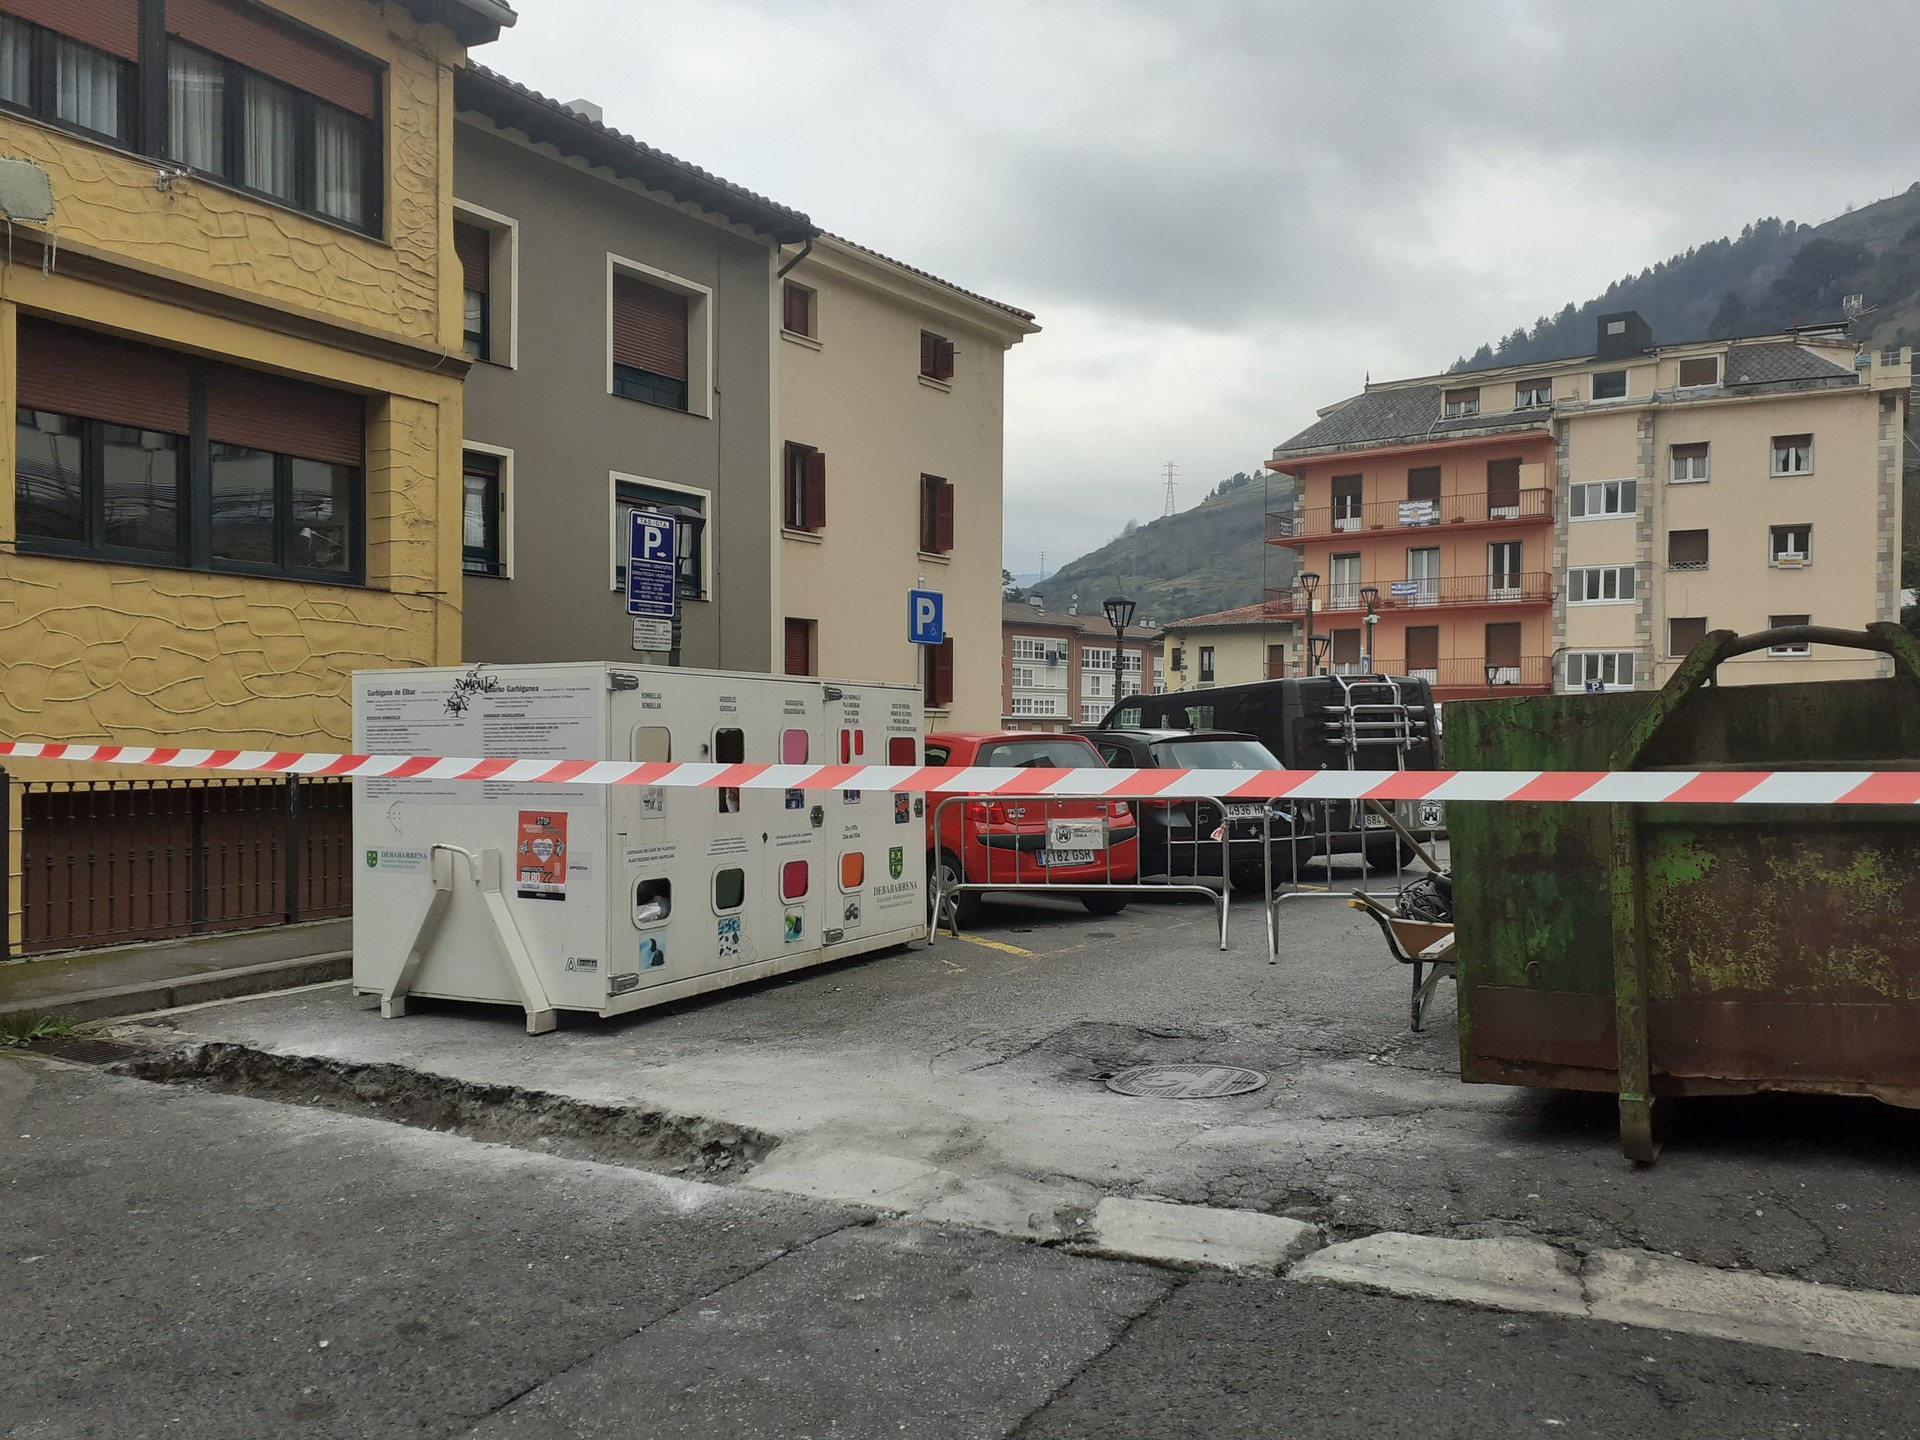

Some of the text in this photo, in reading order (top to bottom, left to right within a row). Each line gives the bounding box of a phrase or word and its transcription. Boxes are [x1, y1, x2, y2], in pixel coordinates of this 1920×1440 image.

[644, 526, 662, 558] P
[917, 598, 935, 635] P
[507, 685, 539, 694] Garbigunea
[1592, 683, 1599, 691] P
[367, 689, 393, 697] Garbigune
[1229, 805, 1251, 816] 4936
[537, 817, 550, 825] STOP
[1072, 849, 1091, 860] GSR
[521, 872, 541, 882] BILBO
[543, 871, 553, 883] 22
[873, 881, 918, 896] DEBABARRENA
